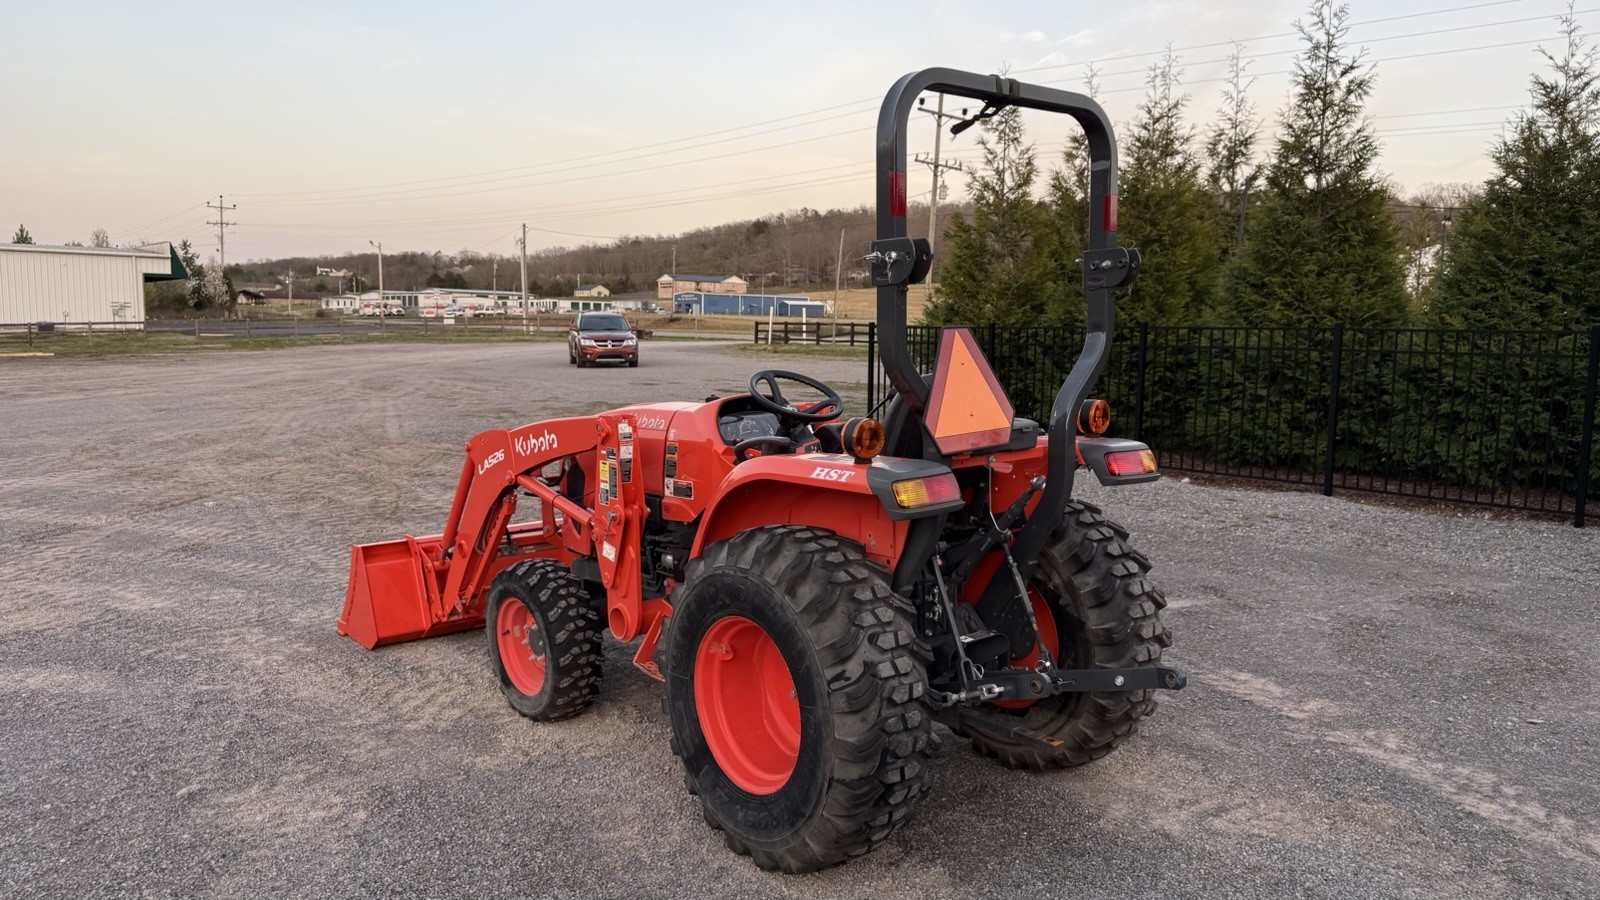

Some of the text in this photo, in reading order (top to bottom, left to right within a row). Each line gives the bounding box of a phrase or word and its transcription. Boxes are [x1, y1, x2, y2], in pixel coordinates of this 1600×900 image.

[514, 429, 558, 457] Kubota
[478, 448, 505, 475] LA526
[809, 466, 856, 482] HST
